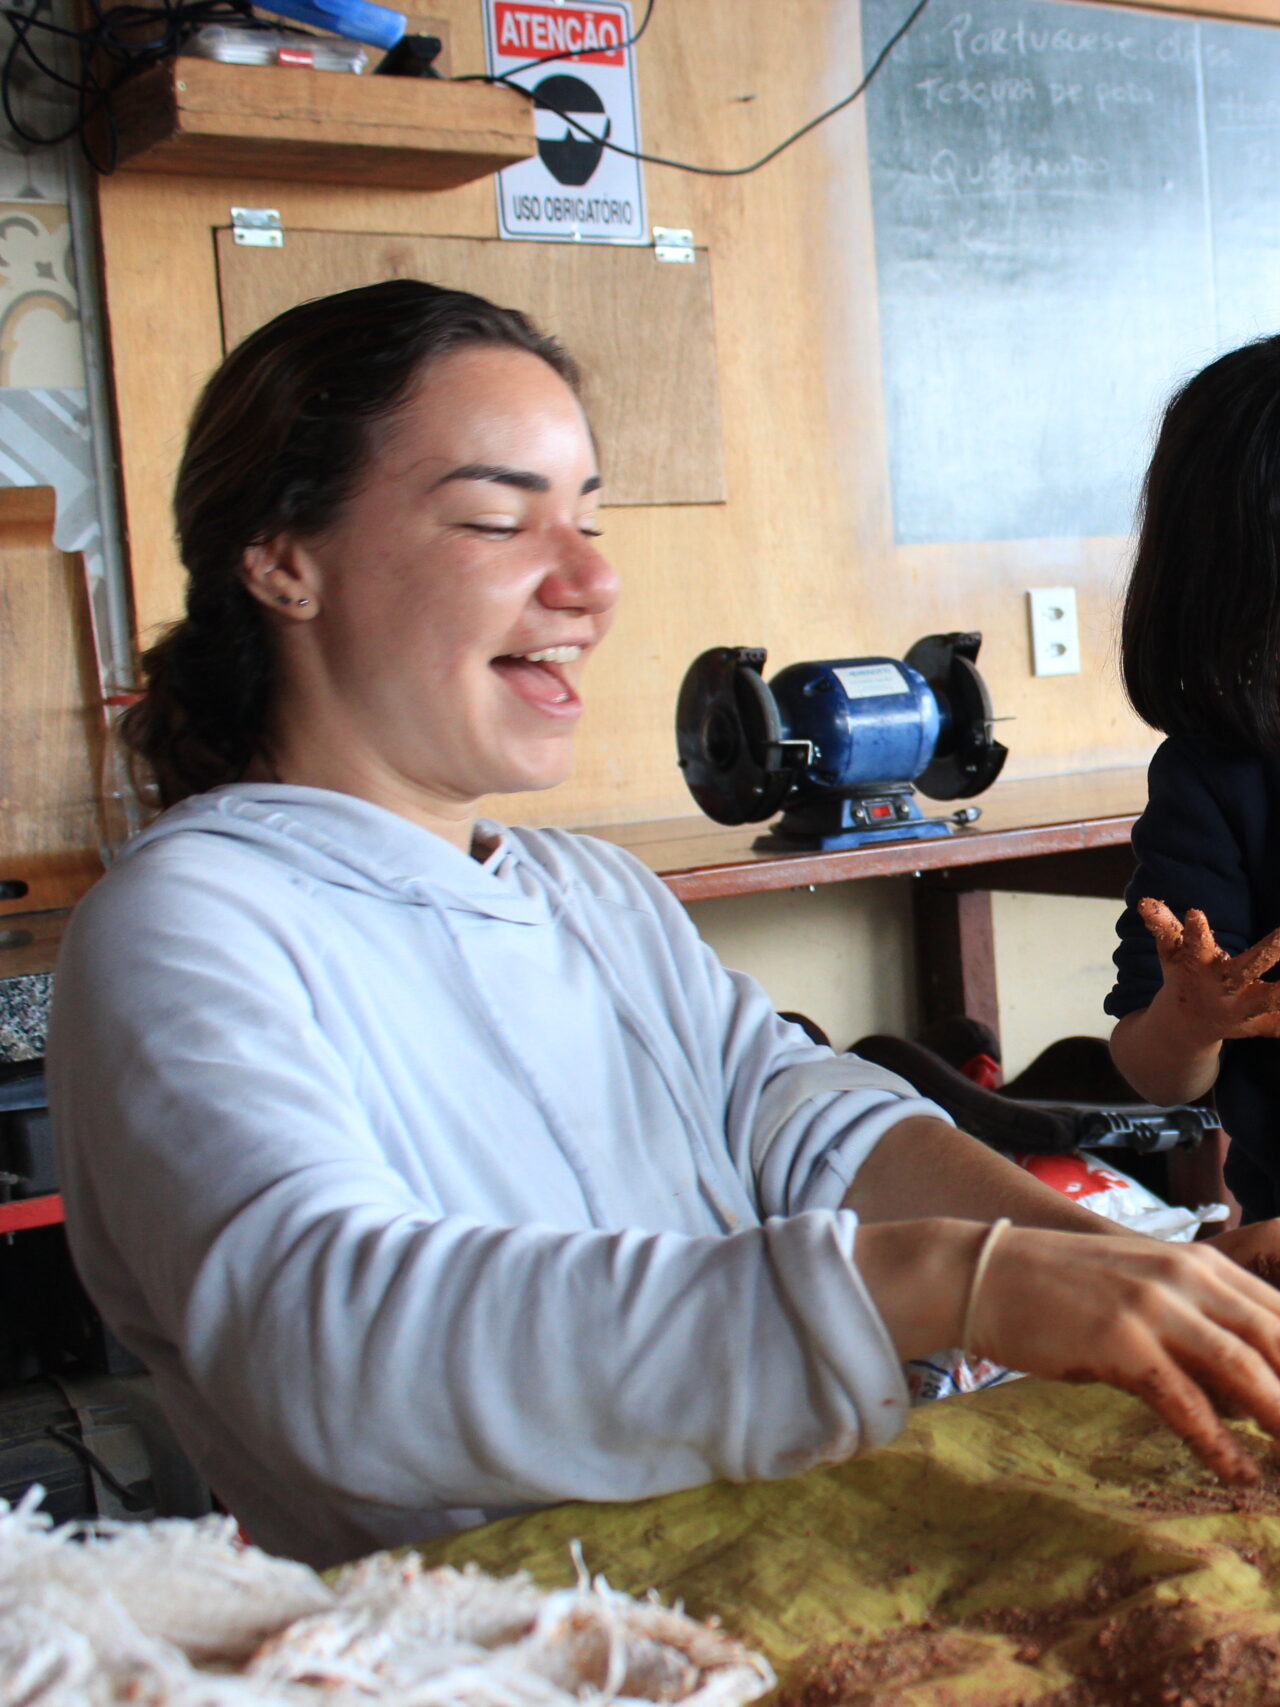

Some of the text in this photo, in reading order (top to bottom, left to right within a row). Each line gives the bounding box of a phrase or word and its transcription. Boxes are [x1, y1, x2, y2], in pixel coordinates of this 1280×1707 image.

[501, 11, 618, 60] ATENÇÃO
[513, 193, 633, 225] USO OBRIGATÓRIO
